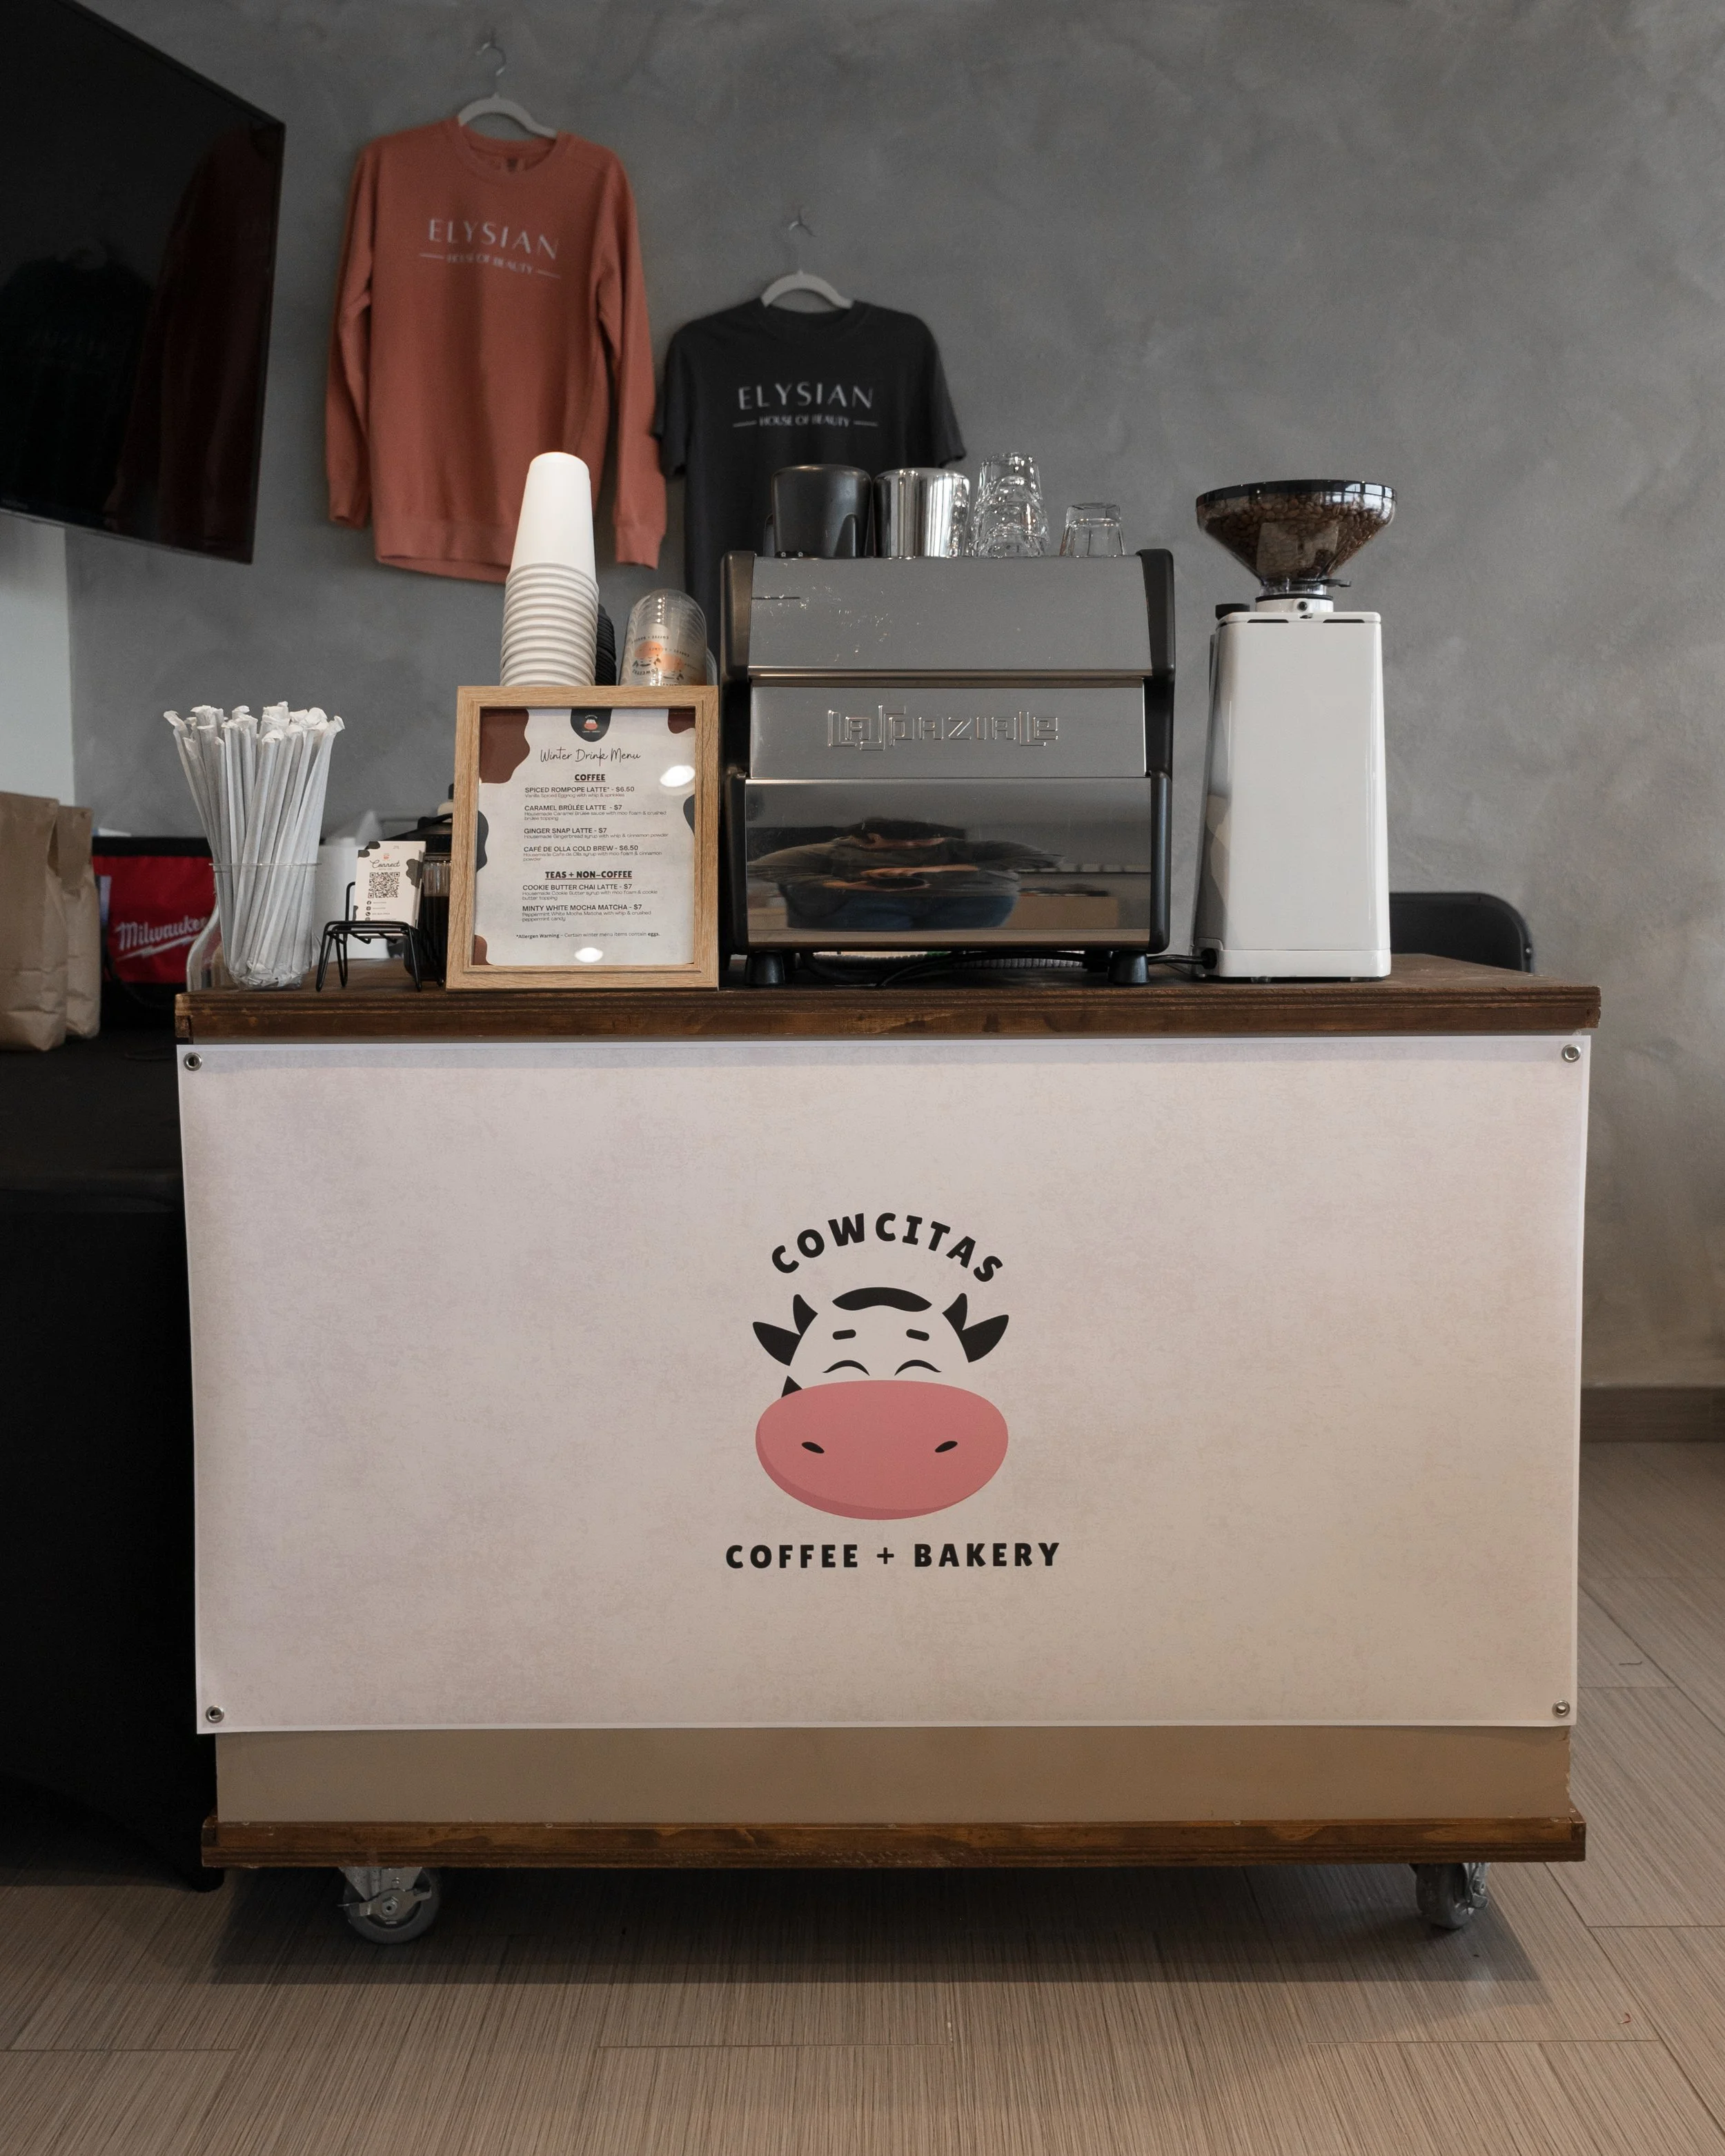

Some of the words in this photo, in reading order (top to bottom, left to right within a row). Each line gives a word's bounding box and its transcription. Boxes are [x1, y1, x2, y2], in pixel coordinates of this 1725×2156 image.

[428, 218, 560, 260] ELYSIAN
[738, 382, 874, 410] ELYSIAN
[541, 746, 572, 762] Winter
[575, 748, 608, 767] Drink
[611, 748, 640, 762] Menu
[369, 860, 400, 869] Connect
[771, 1212, 1003, 1283] COWCITAS
[725, 1544, 858, 1569] COFFEE
[914, 1542, 1060, 1567] BAKERY
